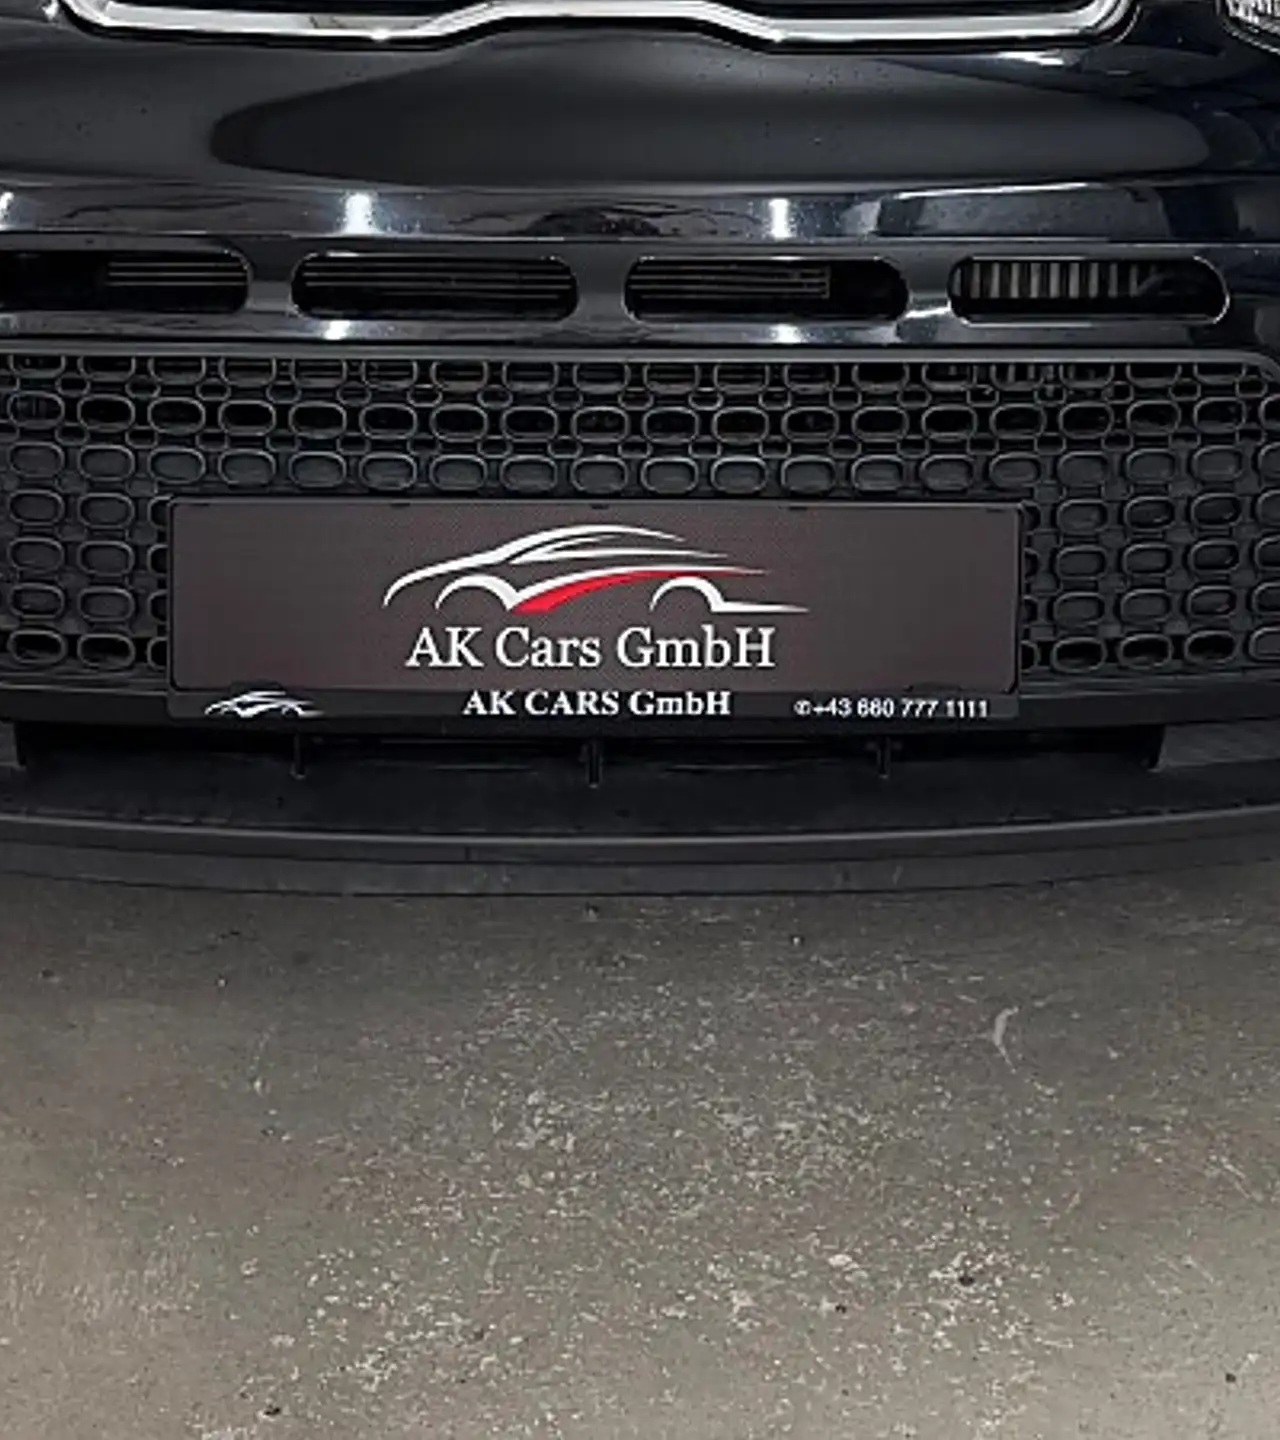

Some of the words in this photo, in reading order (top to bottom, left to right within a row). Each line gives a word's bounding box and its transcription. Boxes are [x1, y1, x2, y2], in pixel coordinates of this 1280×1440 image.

[405, 626, 483, 667] AK
[495, 626, 600, 668] Cars
[616, 624, 775, 668] GmbH
[463, 690, 516, 715] AK
[524, 690, 619, 715] CARS
[628, 690, 731, 715] GmbH
[901, 699, 938, 717] 777
[946, 699, 987, 717] 1111
